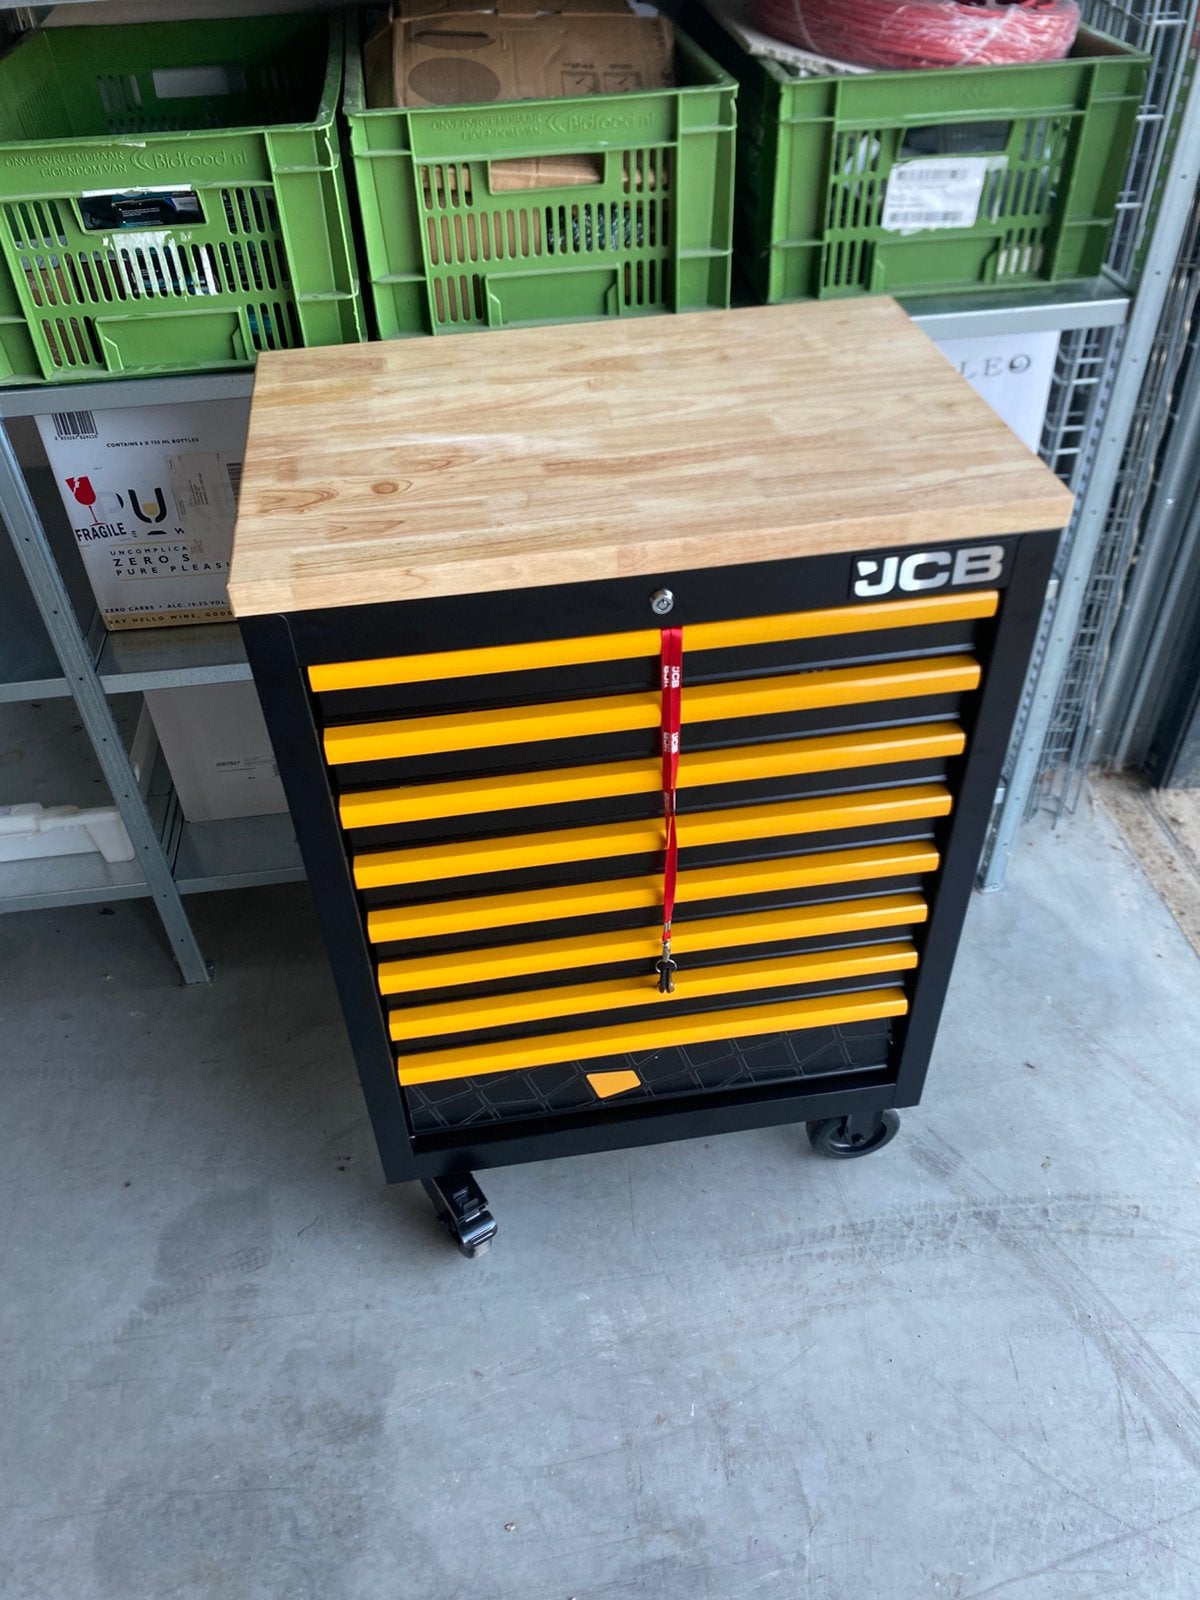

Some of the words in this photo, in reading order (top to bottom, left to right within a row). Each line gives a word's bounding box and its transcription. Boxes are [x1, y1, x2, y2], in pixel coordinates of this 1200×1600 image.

[103, 163, 128, 176] VAN
[75, 522, 127, 542] FRAGILE
[113, 555, 169, 567] ZERO
[116, 567, 159, 576] PURE
[171, 562, 230, 572] PLEAS
[854, 545, 1004, 597] JCB
[671, 665, 681, 689] JCB
